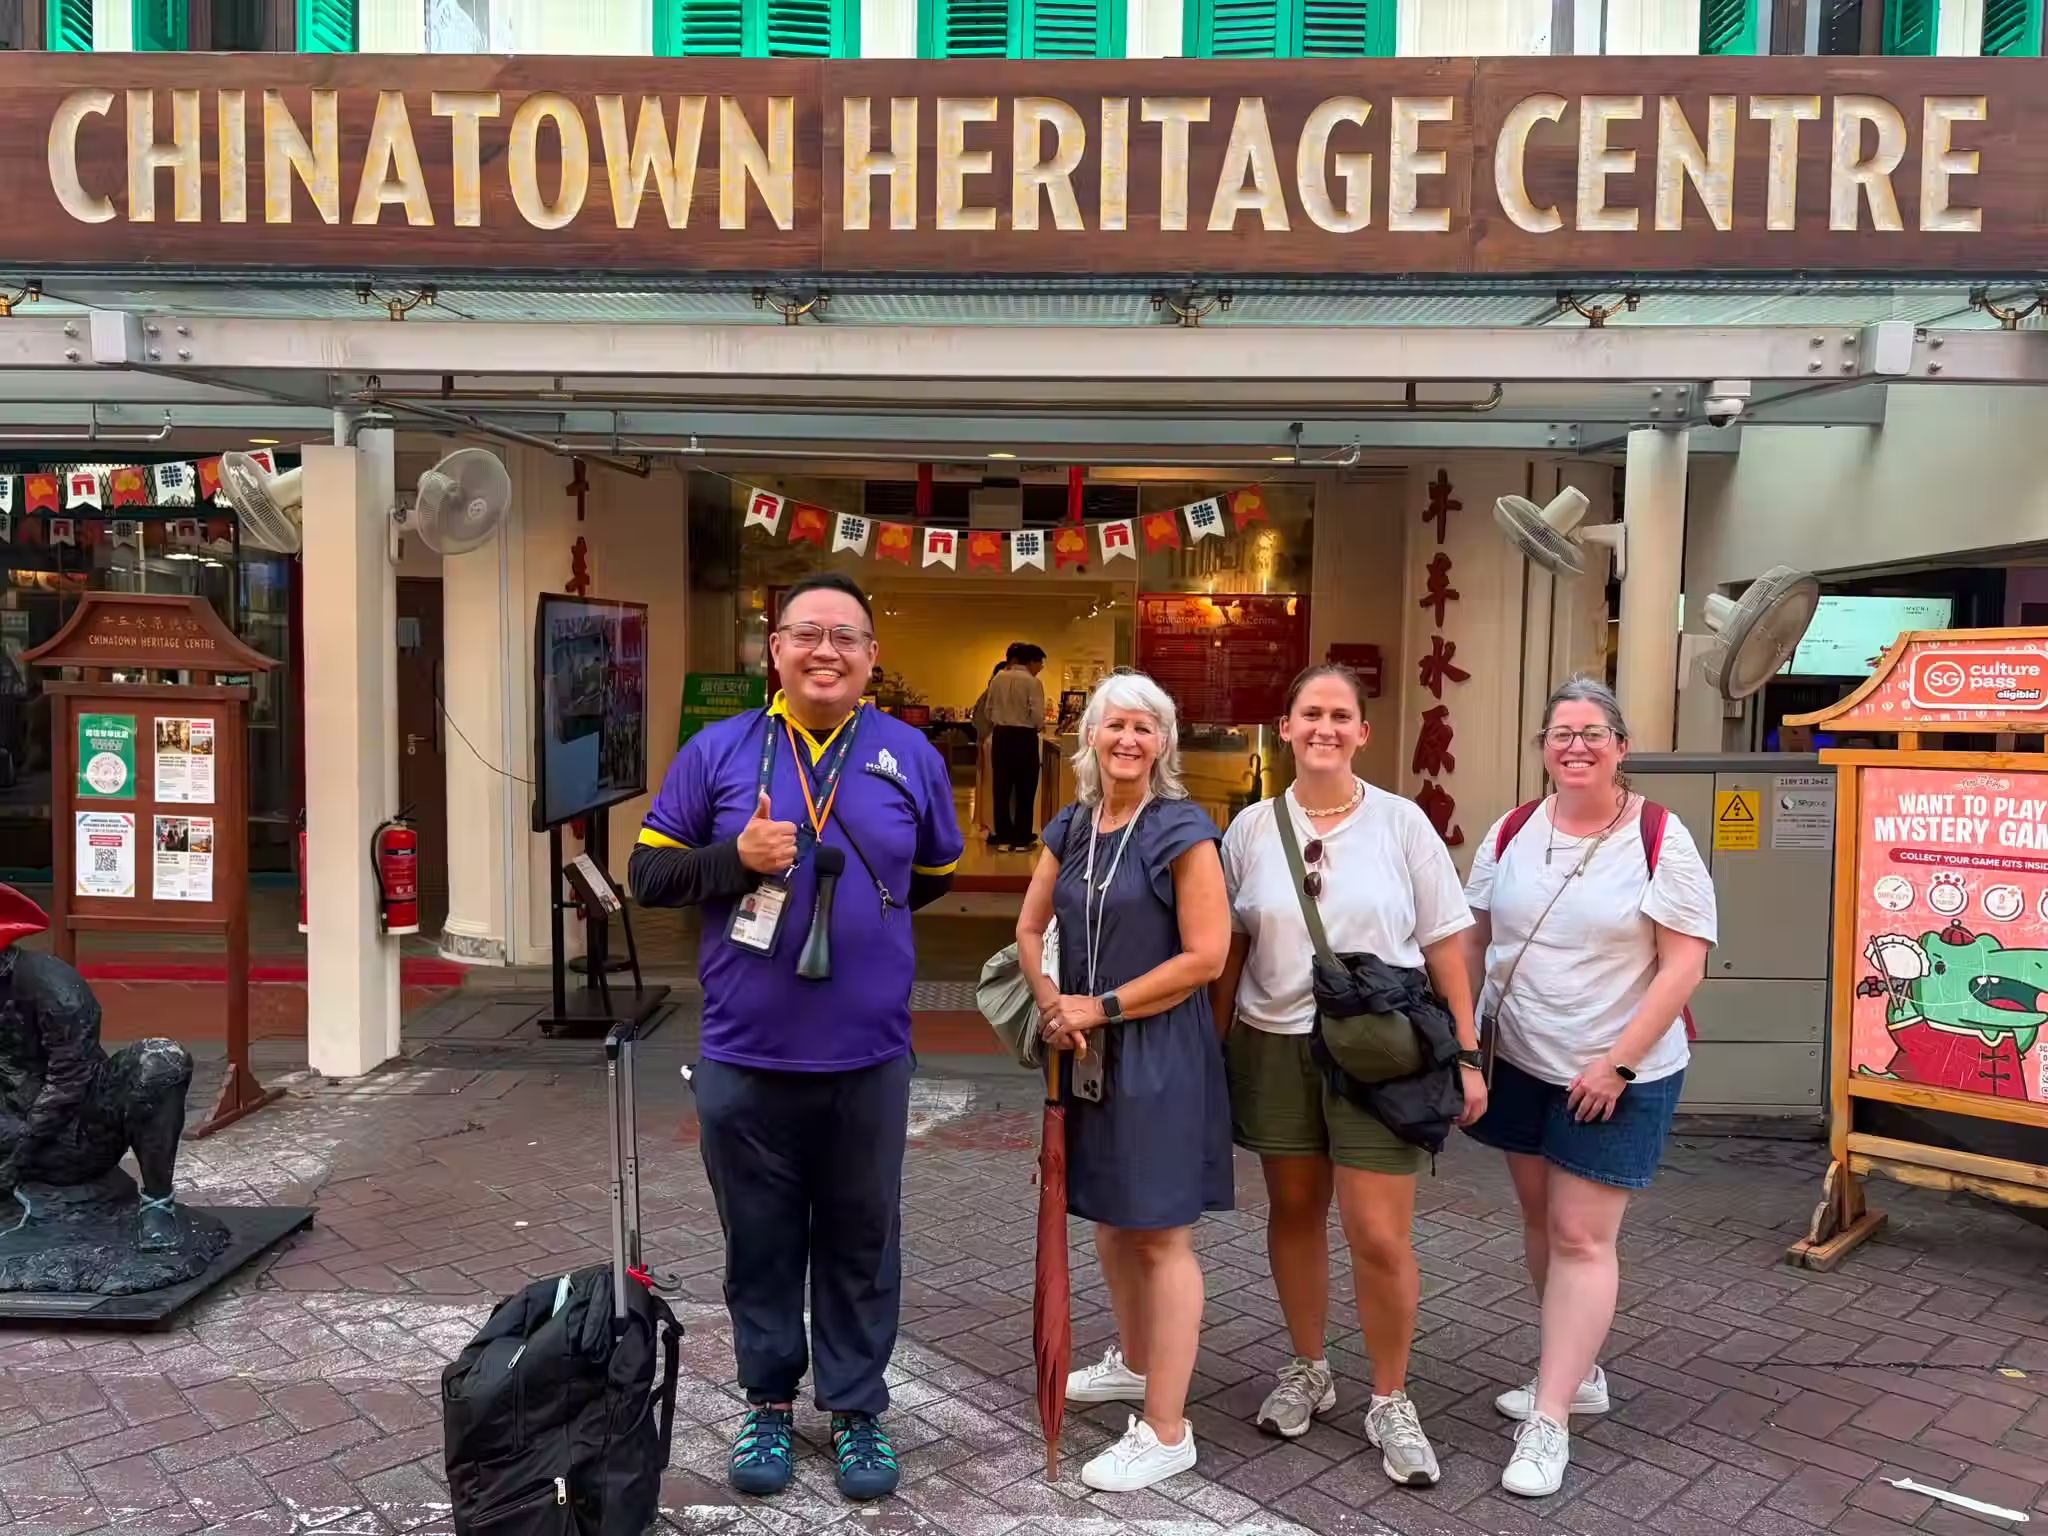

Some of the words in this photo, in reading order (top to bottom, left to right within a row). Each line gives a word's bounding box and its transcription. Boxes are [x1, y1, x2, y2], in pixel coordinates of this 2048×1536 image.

[48, 88, 795, 231] CHINATOWN
[842, 95, 1453, 233] HERITAGE
[1494, 93, 1988, 233] CENTRE
[88, 634, 137, 646] CHINATOWN
[141, 636, 180, 649] HERITAGE
[184, 639, 216, 649] CENTRE
[1969, 661, 2041, 676] culture
[1929, 671, 1960, 687] SG
[1969, 676, 2017, 691] pass
[1996, 689, 2041, 700] eligible!
[1898, 794, 1955, 815] WANT
[1961, 795, 1987, 817] TO
[1994, 798, 2047, 821] PLAY
[1874, 817, 1989, 844] MYSTERY
[1900, 852, 1941, 862] COLLECT
[1943, 855, 1969, 864] YOUR
[1971, 858, 2000, 867] GAME
[2001, 860, 2022, 868] KITS
